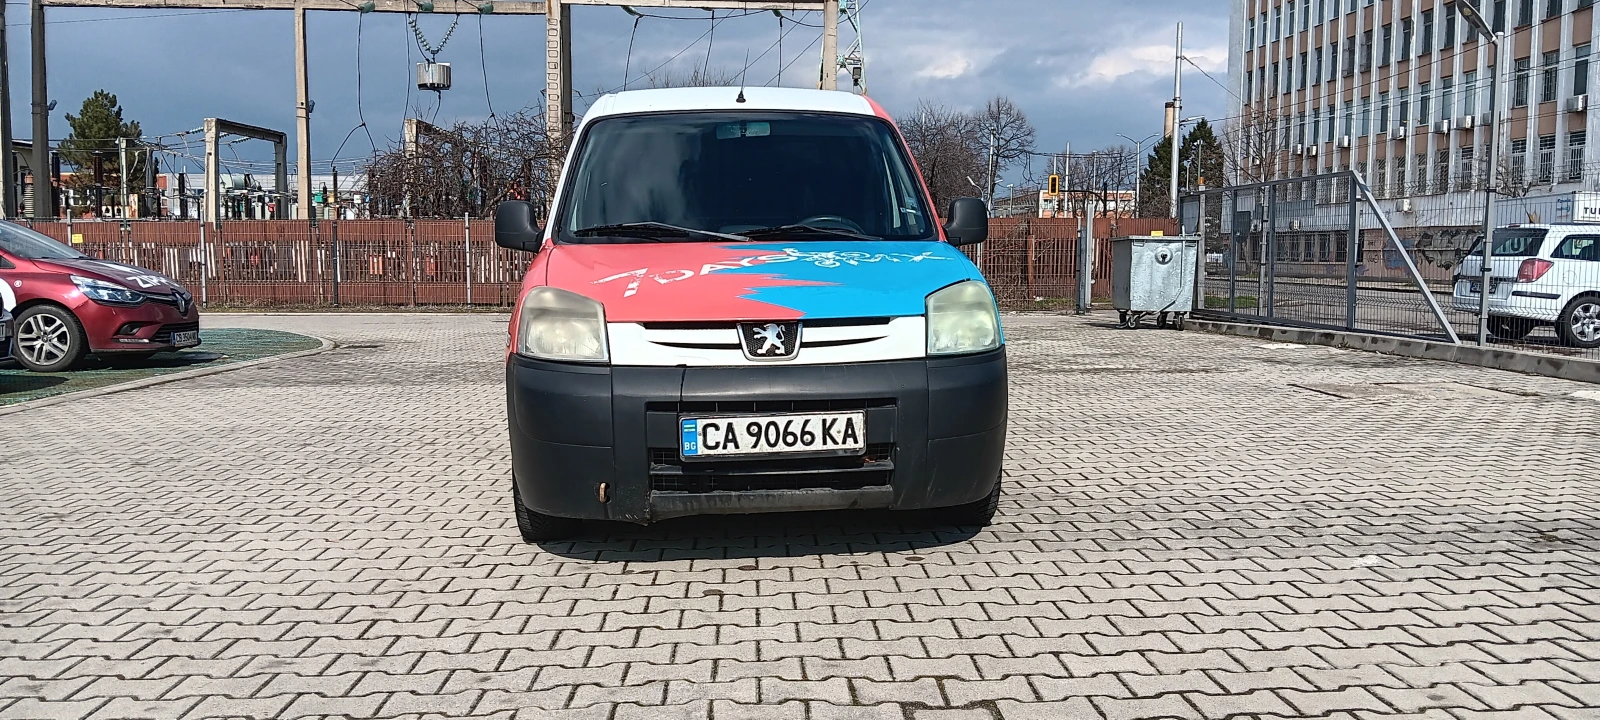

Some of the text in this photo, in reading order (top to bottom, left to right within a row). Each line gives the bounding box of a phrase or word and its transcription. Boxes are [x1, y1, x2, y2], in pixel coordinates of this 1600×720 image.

[1584, 207, 1600, 215] TU
[702, 417, 859, 451] CA 9066 KA
[684, 441, 697, 451] BG
